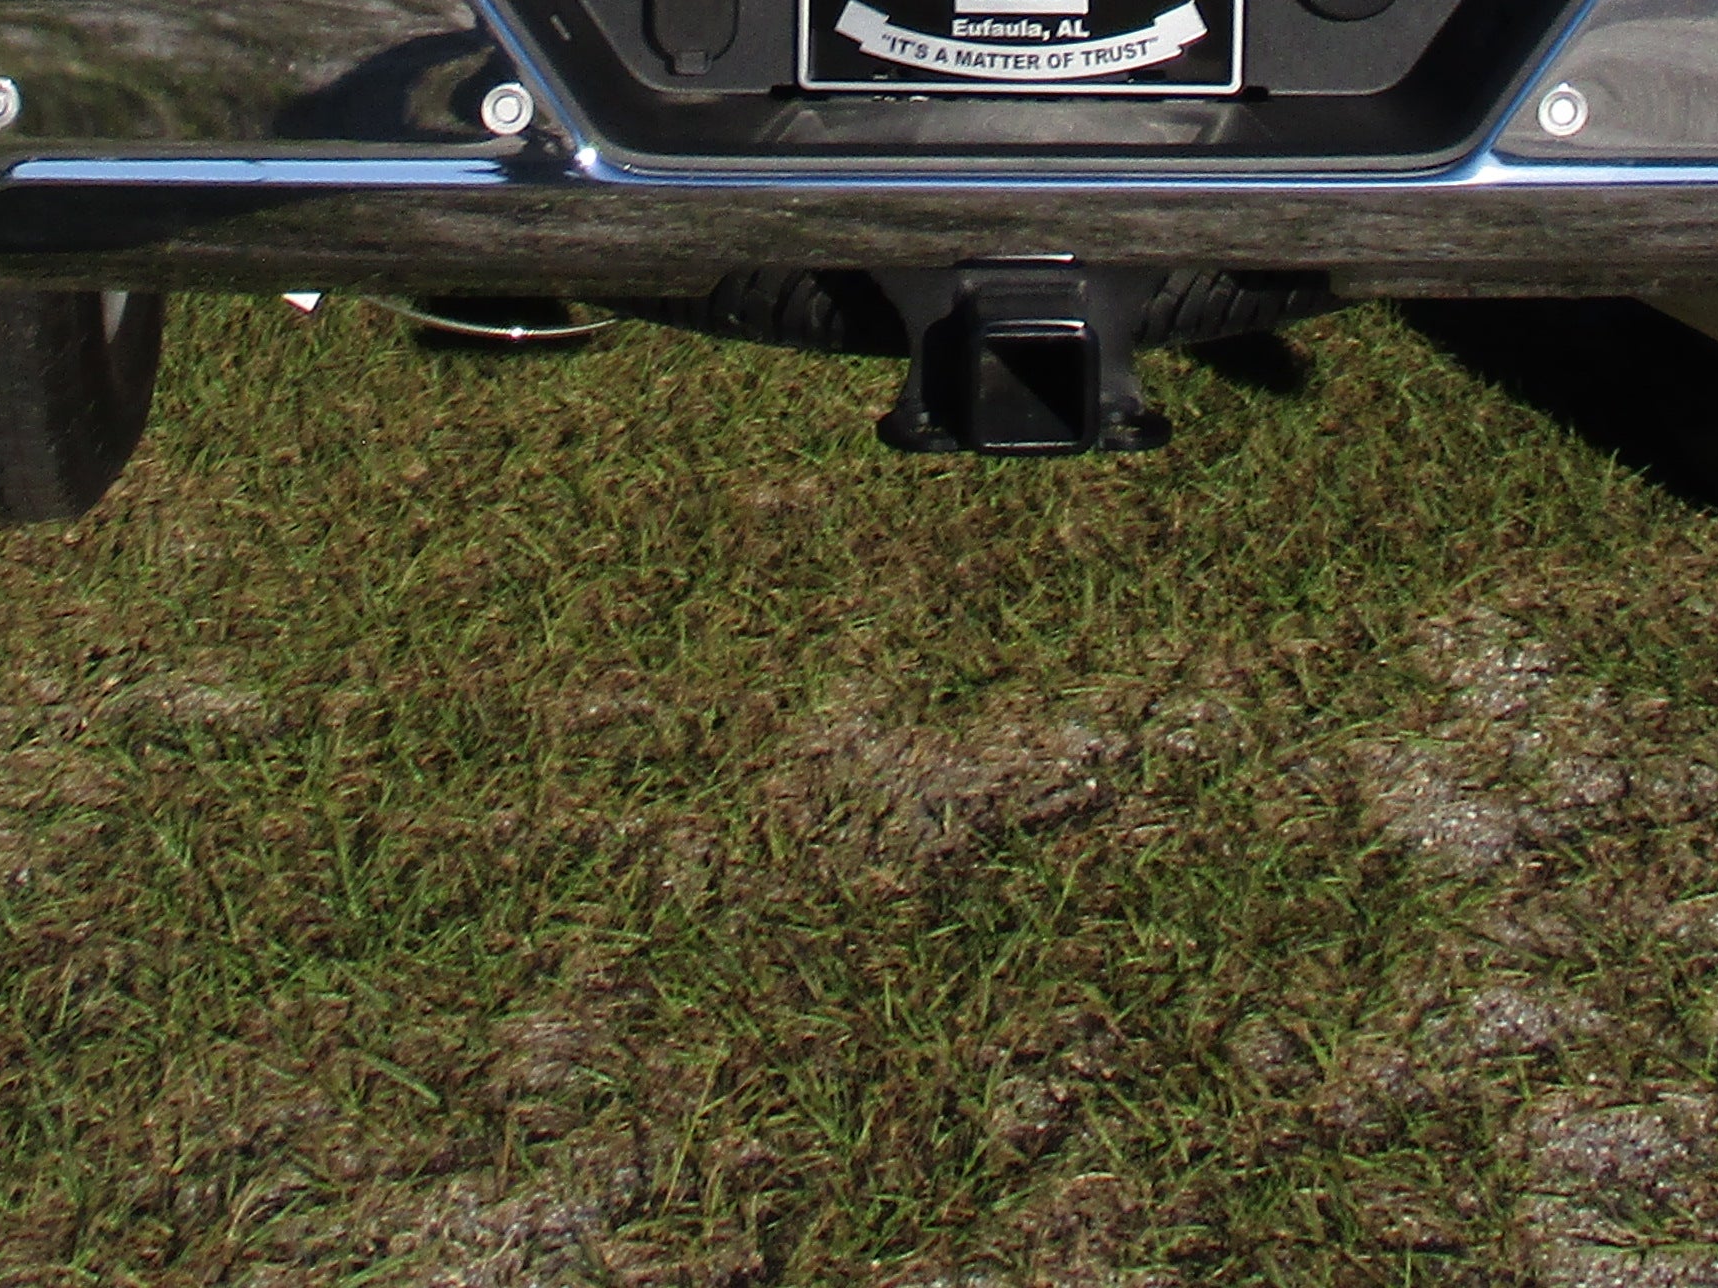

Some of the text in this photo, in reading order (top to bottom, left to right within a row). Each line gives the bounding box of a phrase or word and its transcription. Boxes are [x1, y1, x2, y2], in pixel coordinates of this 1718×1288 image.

[951, 18, 1091, 42] Eufaula, AL
[935, 47, 949, 64] A
[955, 49, 1040, 70] MATTER
[1047, 52, 1075, 69] OF
